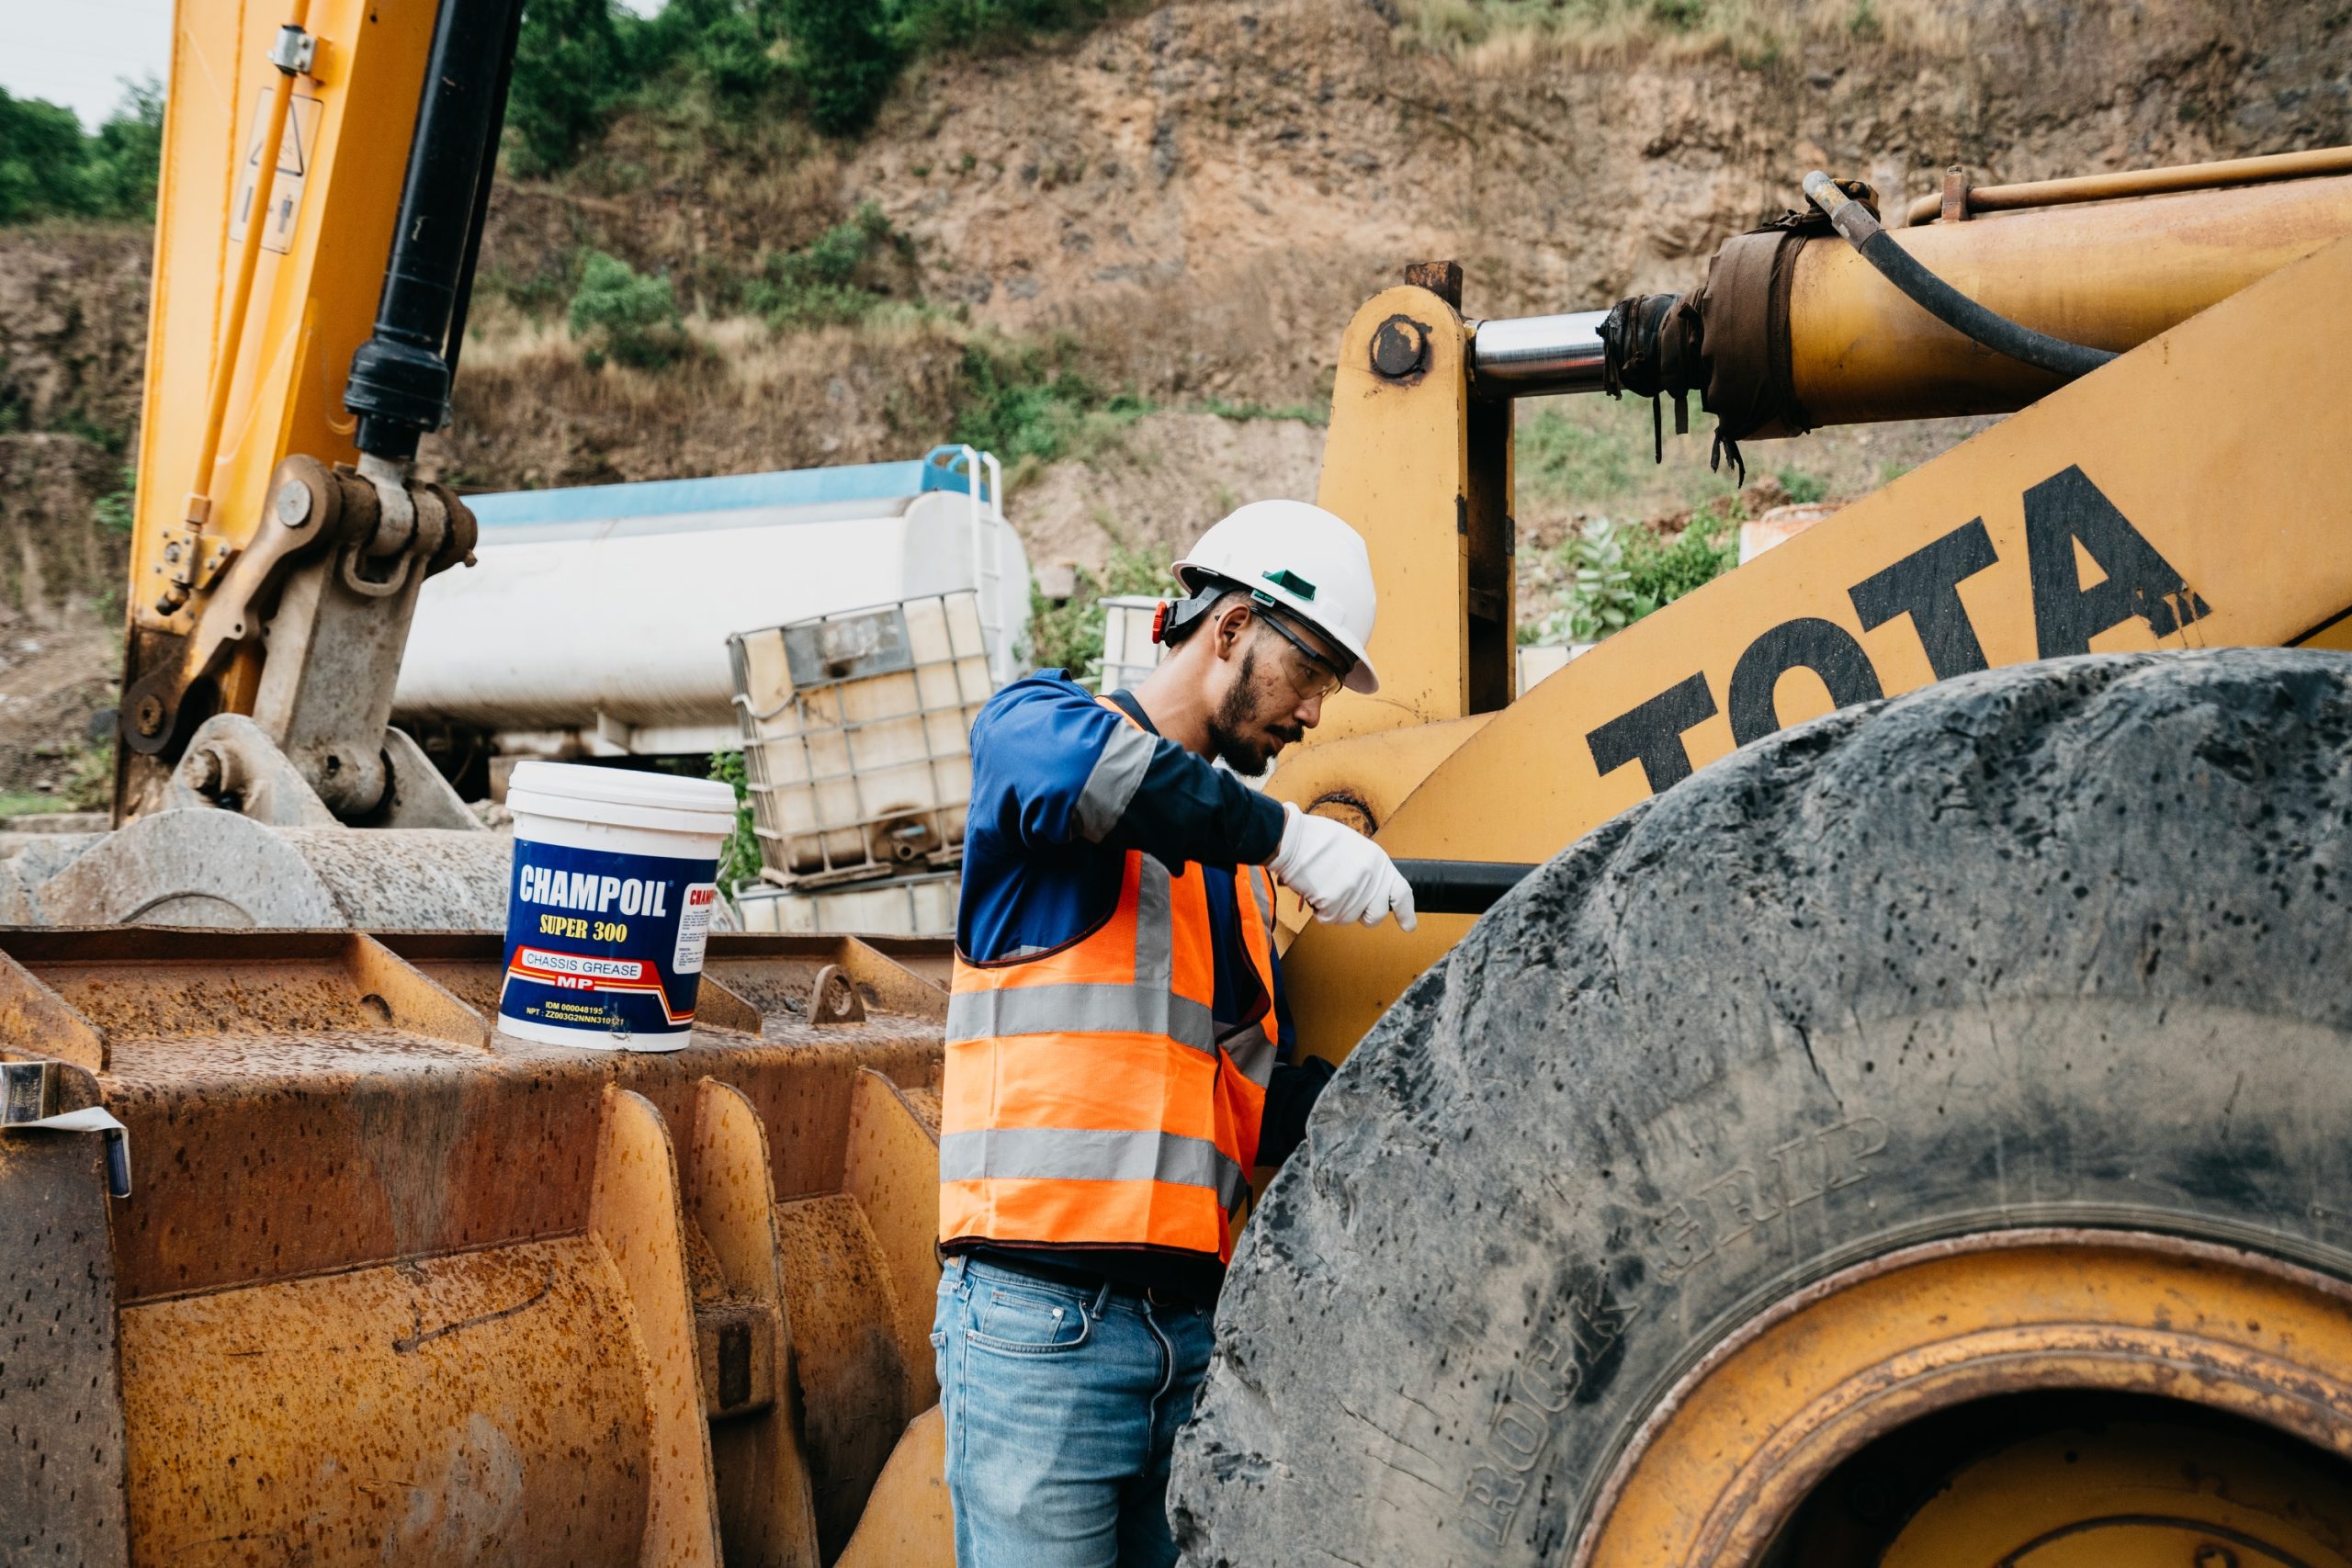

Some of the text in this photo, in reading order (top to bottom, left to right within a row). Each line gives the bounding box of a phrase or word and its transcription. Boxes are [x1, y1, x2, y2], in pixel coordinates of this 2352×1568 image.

[1586, 463, 2211, 795] TOTA
[519, 863, 666, 918] CHAMPOIL
[539, 914, 628, 942] SUPER 300
[526, 953, 639, 976] CHASSIS GREASE
[557, 976, 594, 989] MP
[526, 1007, 539, 1016] NPT
[545, 1001, 604, 1015] IDM 000048195
[1459, 1275, 1642, 1548] ROCK
